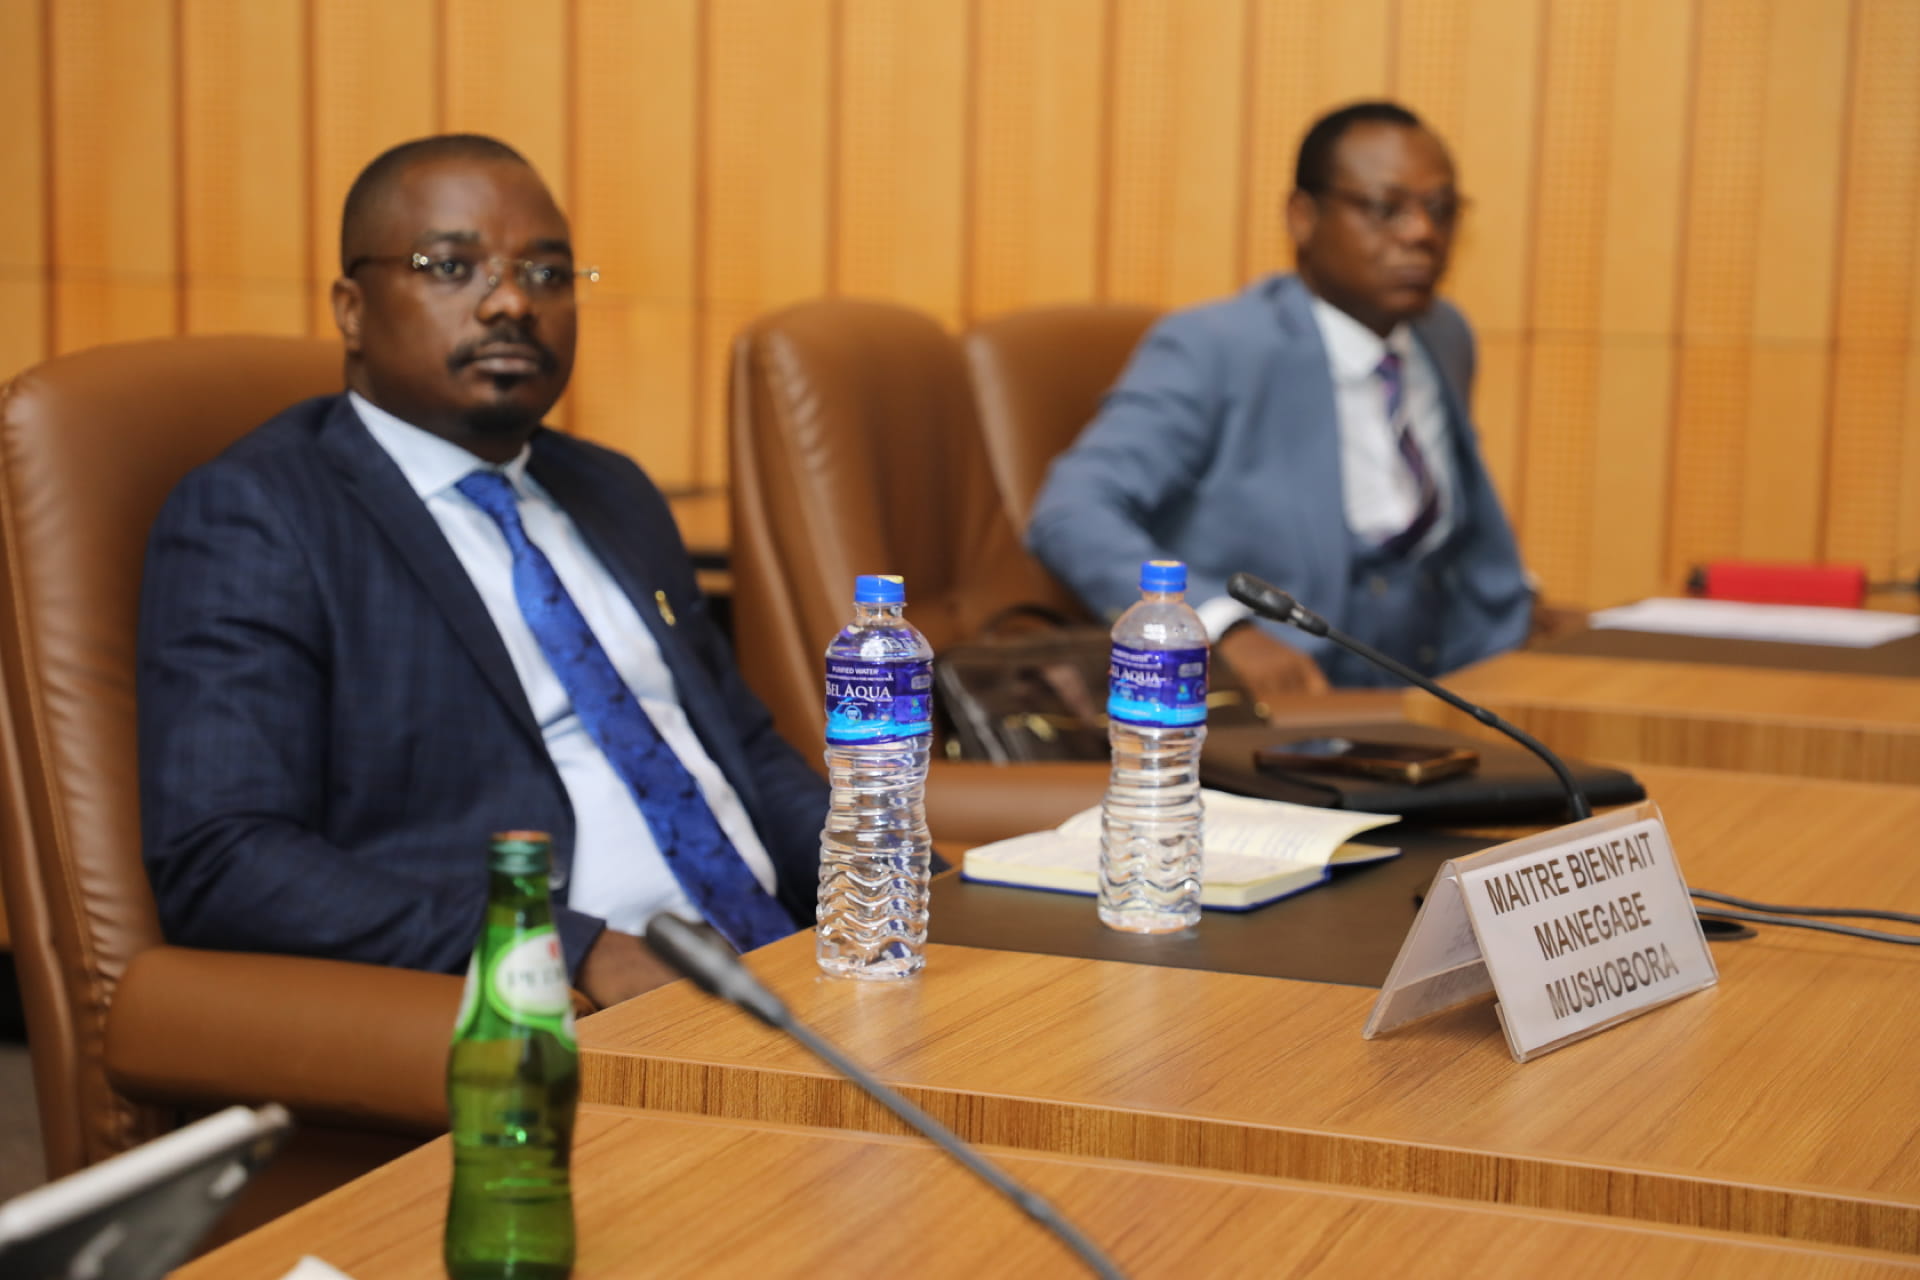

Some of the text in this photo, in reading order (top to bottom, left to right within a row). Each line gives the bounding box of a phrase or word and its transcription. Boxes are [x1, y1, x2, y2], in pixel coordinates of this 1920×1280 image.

[844, 683, 892, 702] AQUA
[855, 667, 879, 675] WATER
[1120, 668, 1161, 687] AQUA
[1484, 859, 1569, 915] MAITRE
[1566, 832, 1655, 889] BIENFAIT
[1534, 892, 1652, 960] MANEGABE
[1545, 943, 1680, 1019] MUSHOBORA
